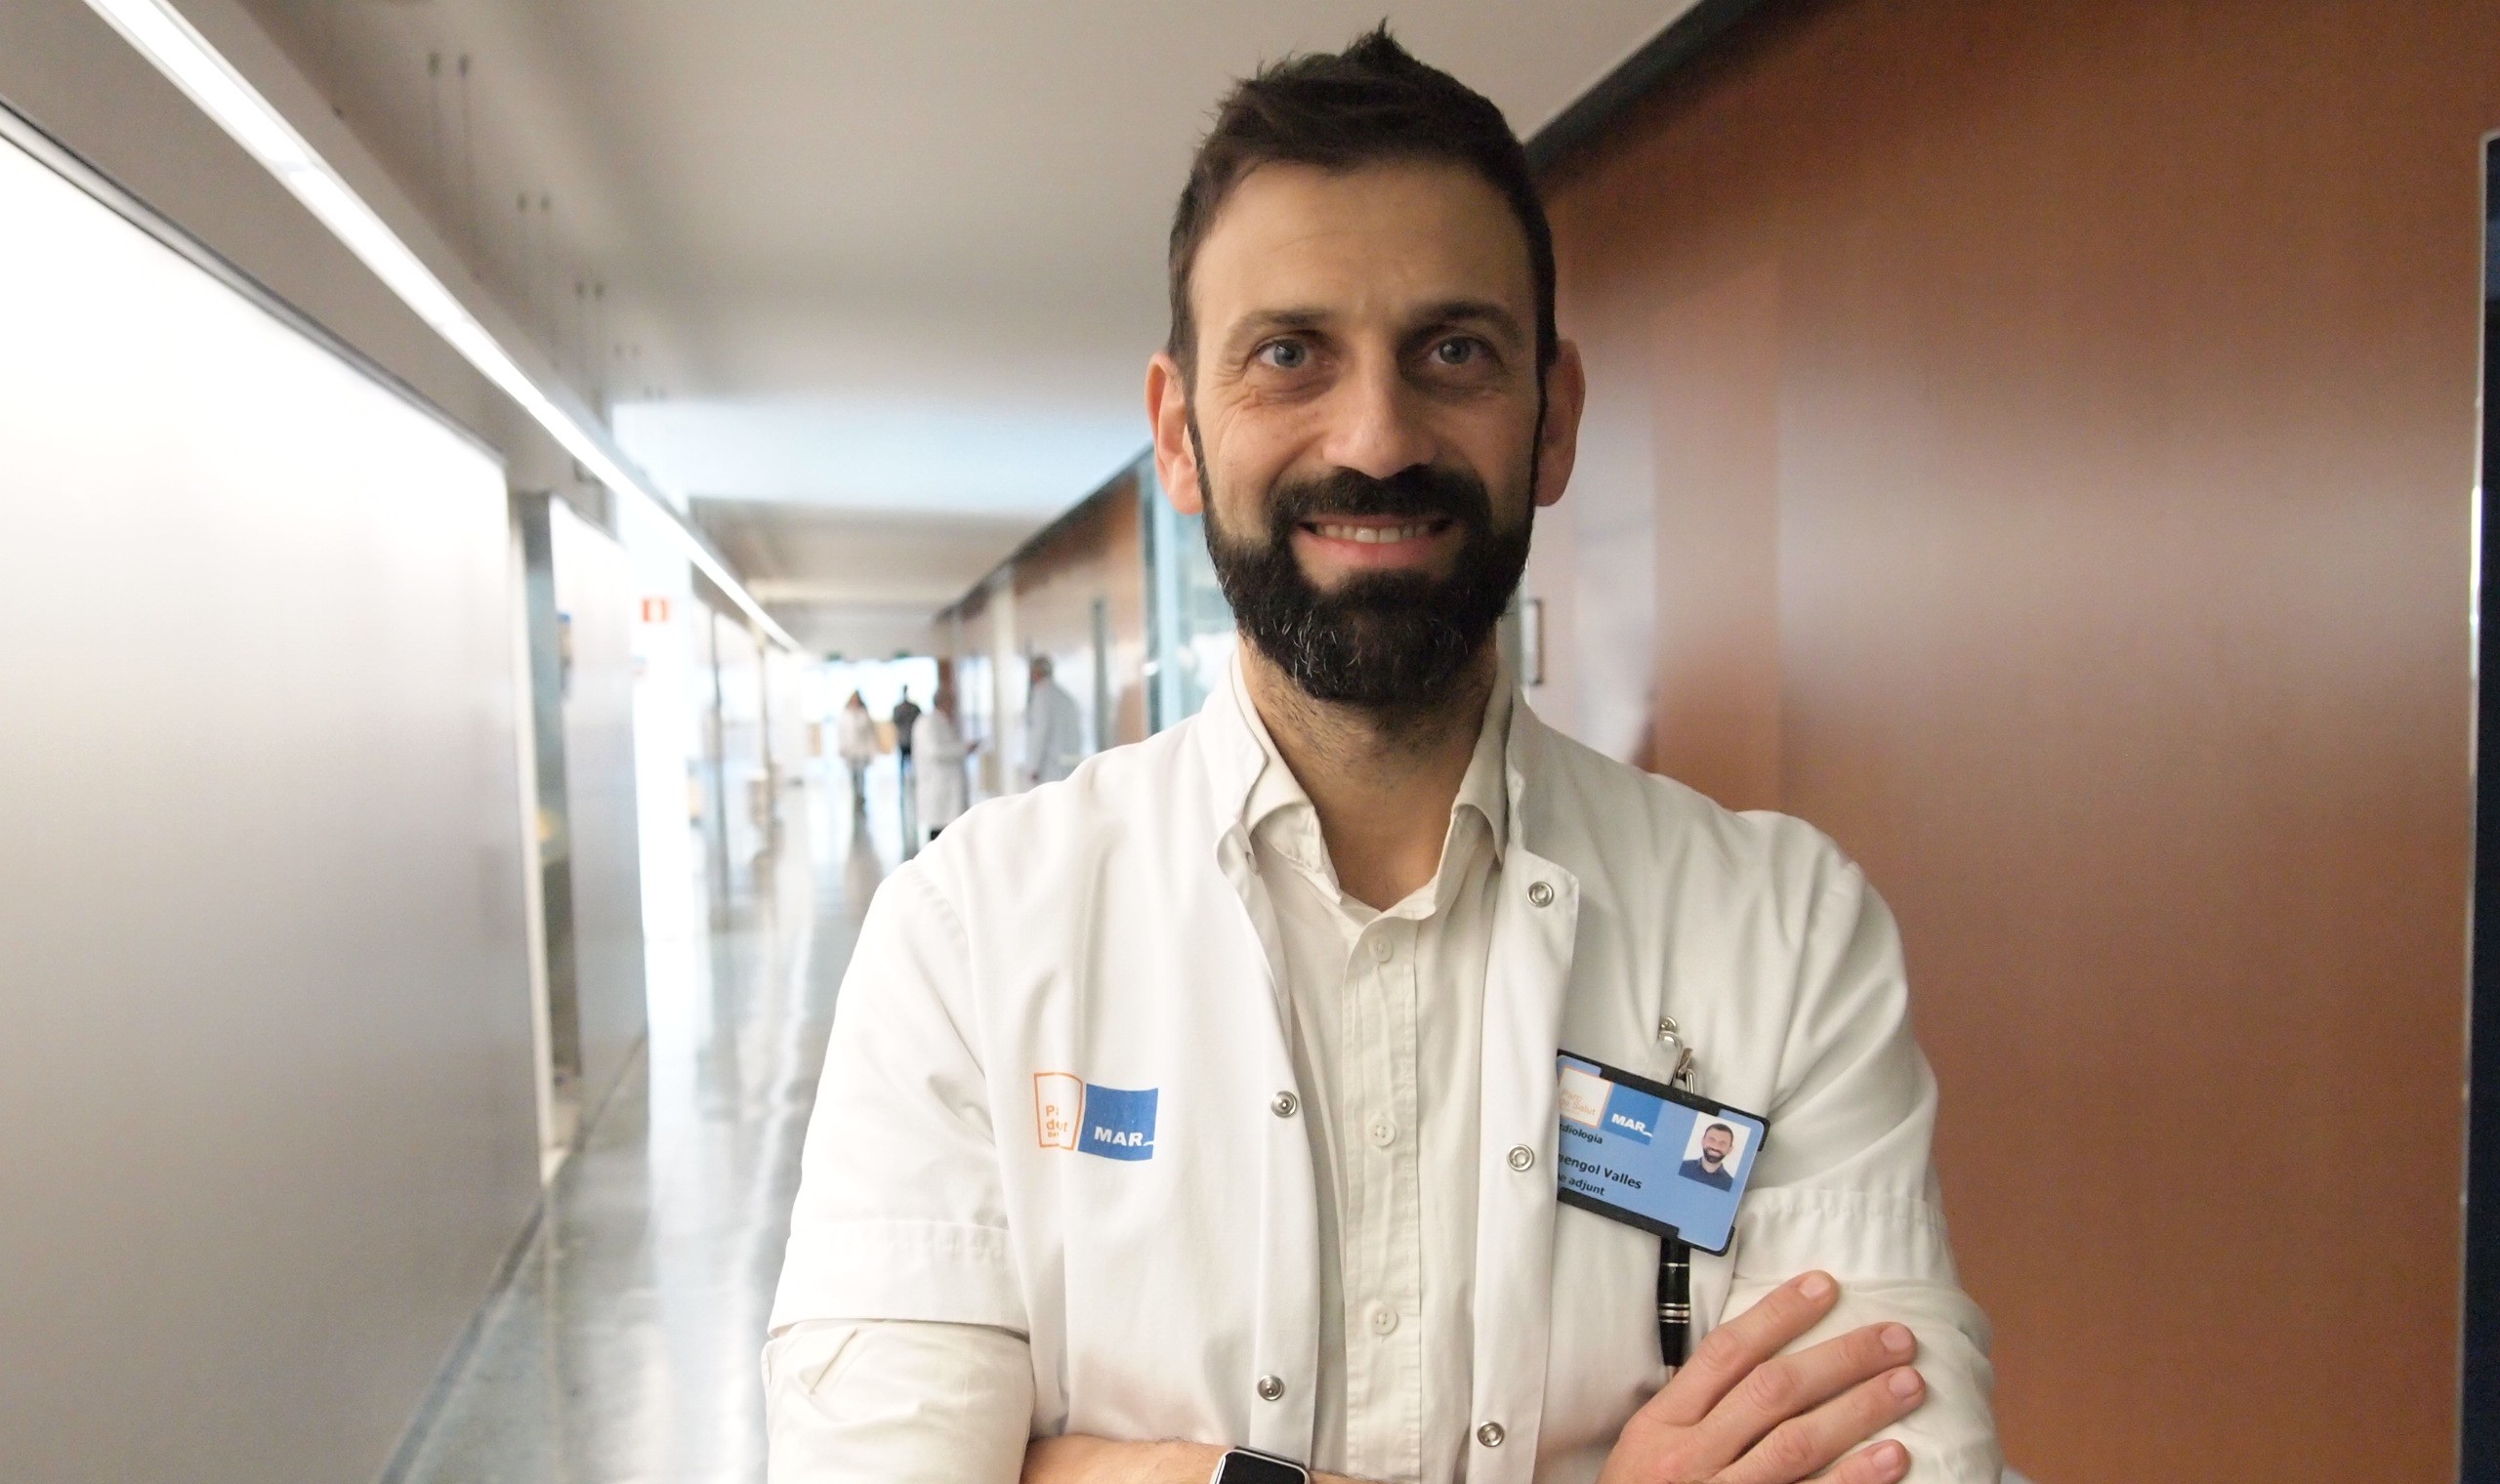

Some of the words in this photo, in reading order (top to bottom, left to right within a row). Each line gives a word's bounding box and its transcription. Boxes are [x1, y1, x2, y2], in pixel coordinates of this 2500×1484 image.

[1572, 1101, 1596, 1115] Salut
[1568, 1177, 1605, 1196] adjunt
[1604, 1167, 1643, 1189] Valles
